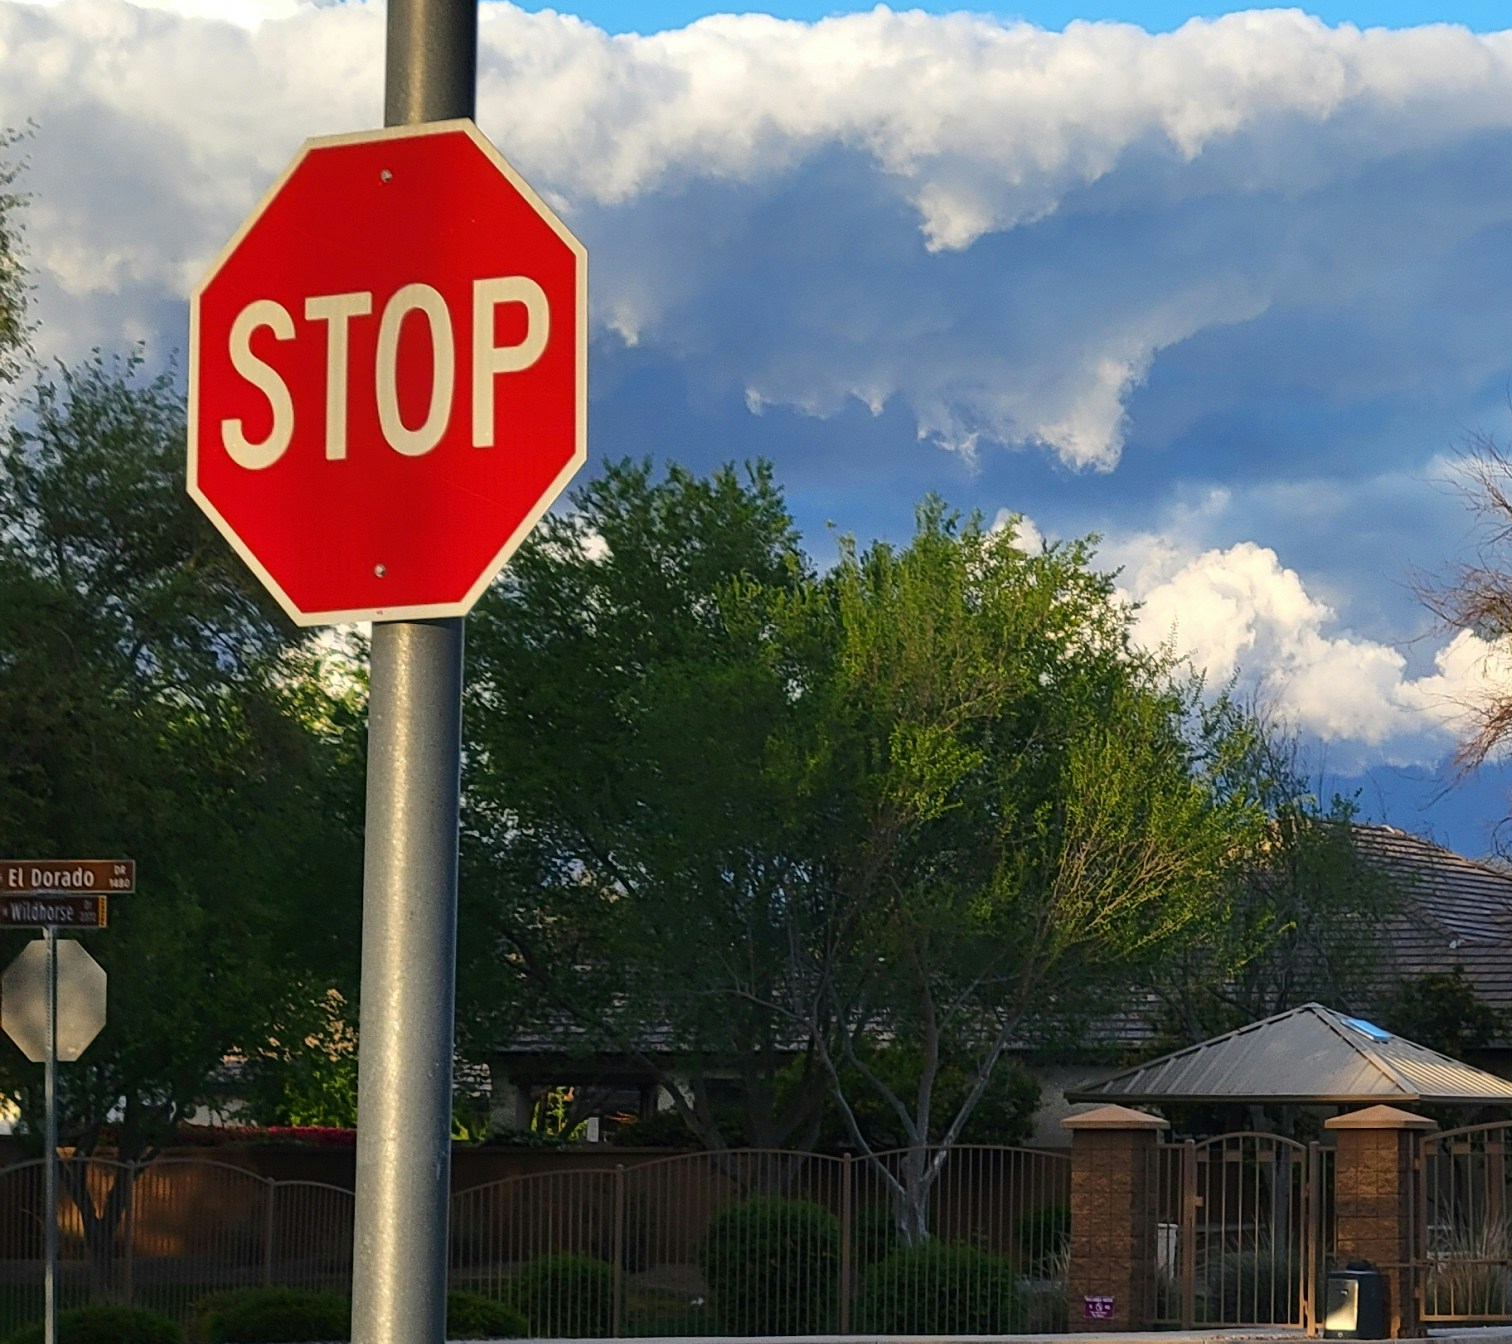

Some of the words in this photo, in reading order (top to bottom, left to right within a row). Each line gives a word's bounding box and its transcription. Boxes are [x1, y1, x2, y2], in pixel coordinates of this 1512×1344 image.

[220, 274, 550, 471] STOP
[8, 867, 24, 888] El
[31, 867, 95, 888] Dorado
[113, 864, 127, 876] DR
[10, 902, 74, 922] Wildhorse
